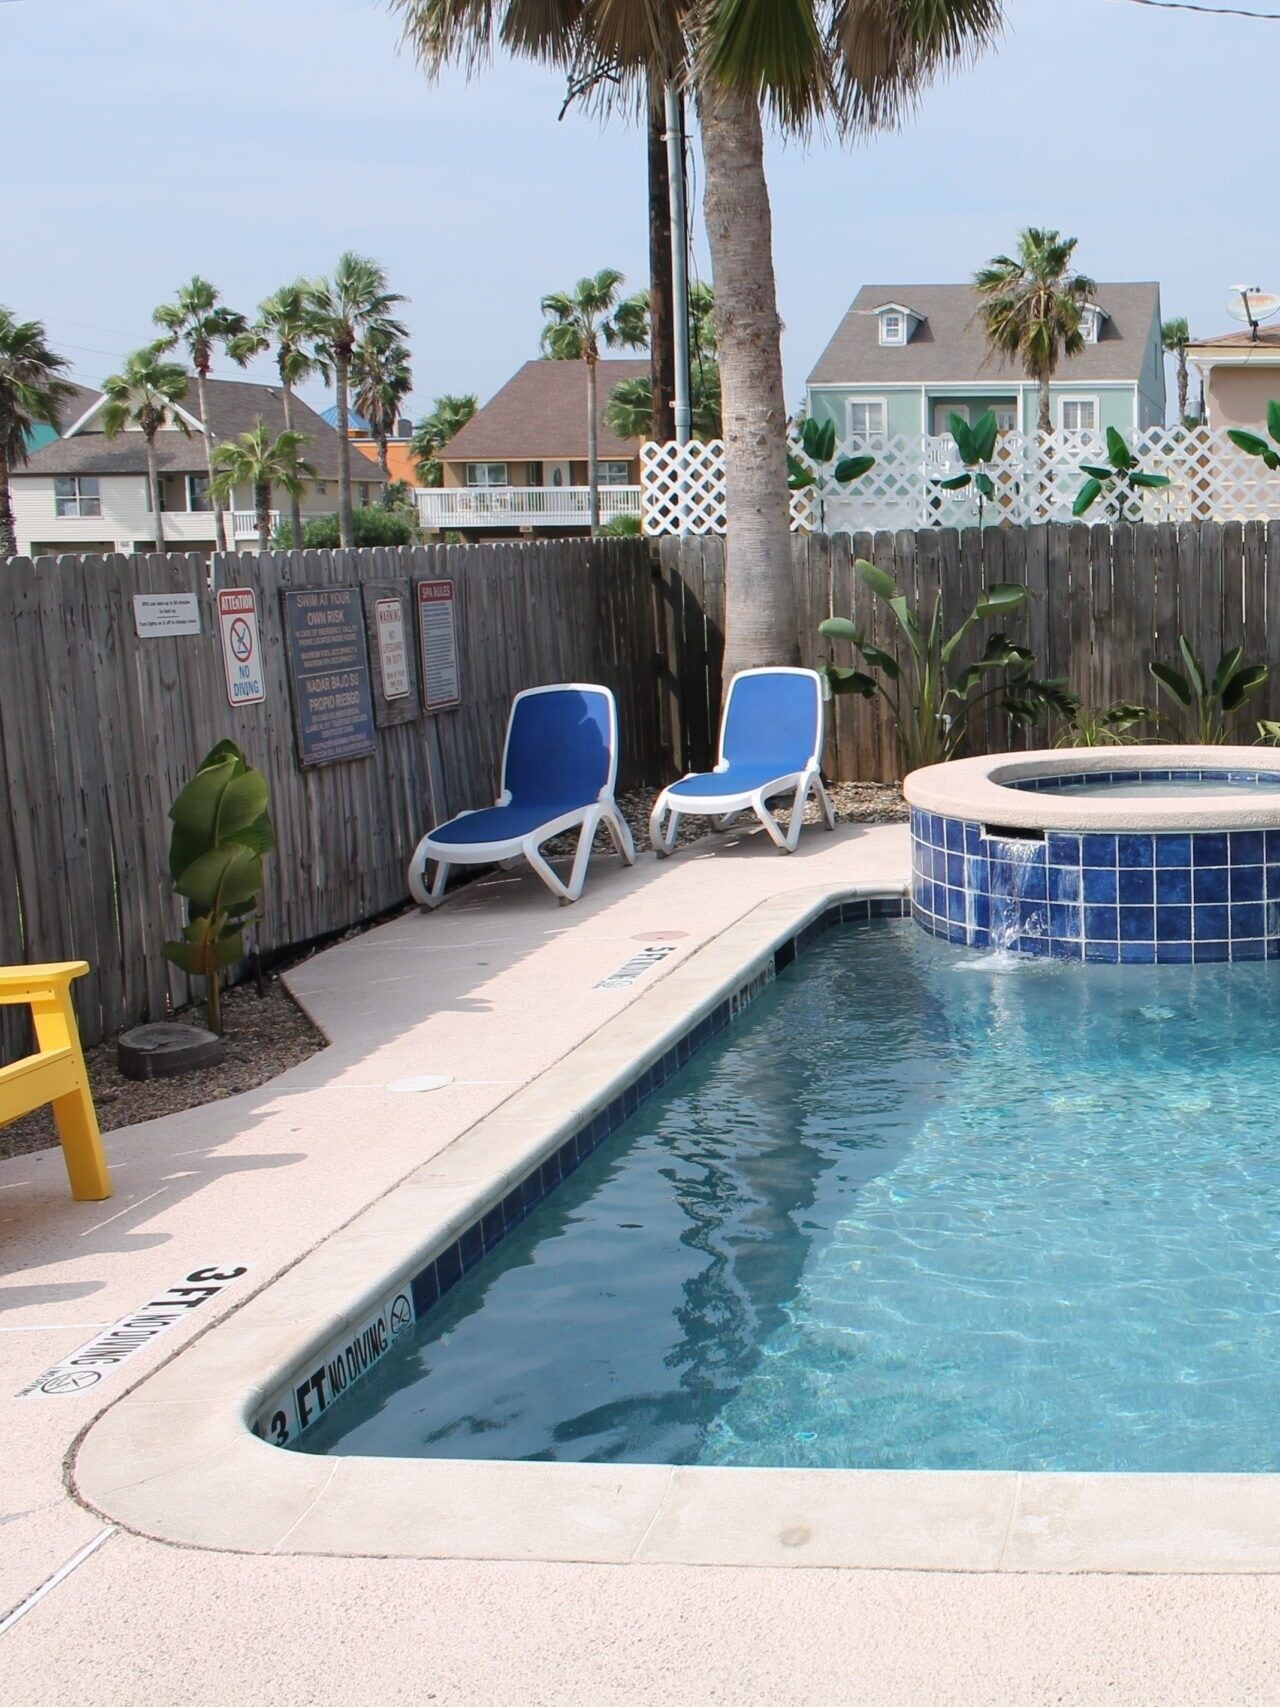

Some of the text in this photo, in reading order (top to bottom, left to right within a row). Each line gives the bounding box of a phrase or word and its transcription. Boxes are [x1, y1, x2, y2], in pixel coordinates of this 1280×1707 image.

[296, 592, 351, 608] SWIM AT YOUR
[422, 585, 450, 599] SPA RULES
[221, 595, 253, 611] ATTENTION
[307, 610, 345, 626] OWN RISK
[379, 609, 401, 624] WARNING
[239, 665, 250, 679] NO
[233, 680, 260, 697] DIVING
[306, 672, 359, 693] NADAR BAJO SU
[309, 690, 360, 713] PROPIO RIESGO
[70, 1266, 248, 1366] 3 FT. NO DIVING
[270, 1409, 290, 1446] 3
[327, 1354, 347, 1398] NO
[345, 1317, 389, 1382] DIVING
